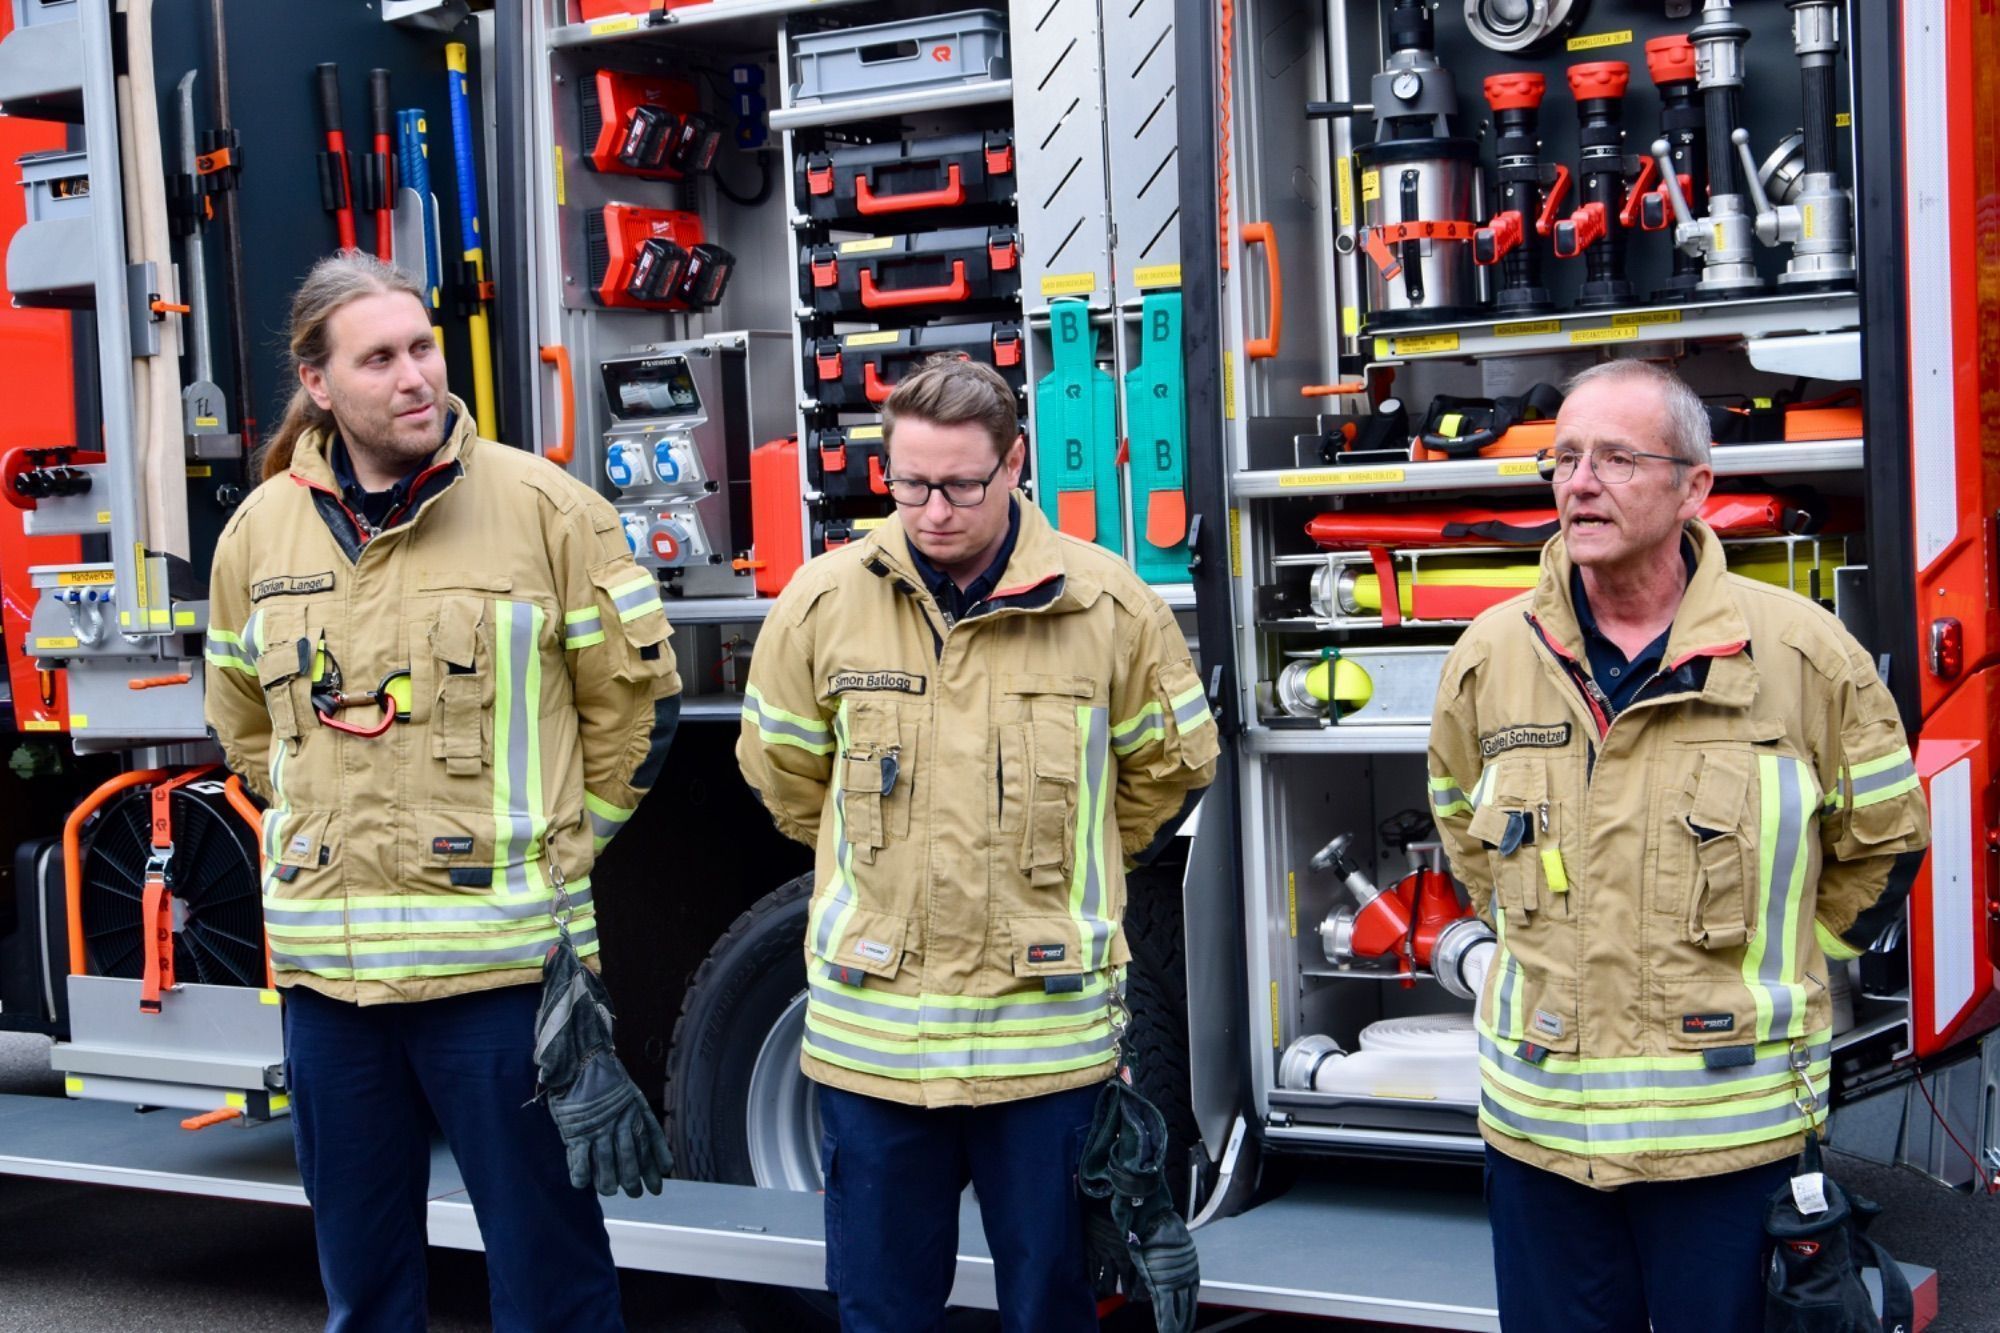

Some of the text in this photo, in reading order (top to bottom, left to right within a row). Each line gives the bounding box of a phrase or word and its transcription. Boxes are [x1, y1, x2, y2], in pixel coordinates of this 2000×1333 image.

[1061, 312, 1078, 343] B
[1153, 309, 1170, 342] B
[1065, 439, 1083, 470] B
[1156, 439, 1172, 470] B
[290, 578, 324, 591] Langer
[1510, 729, 1564, 745] Schnetzer
